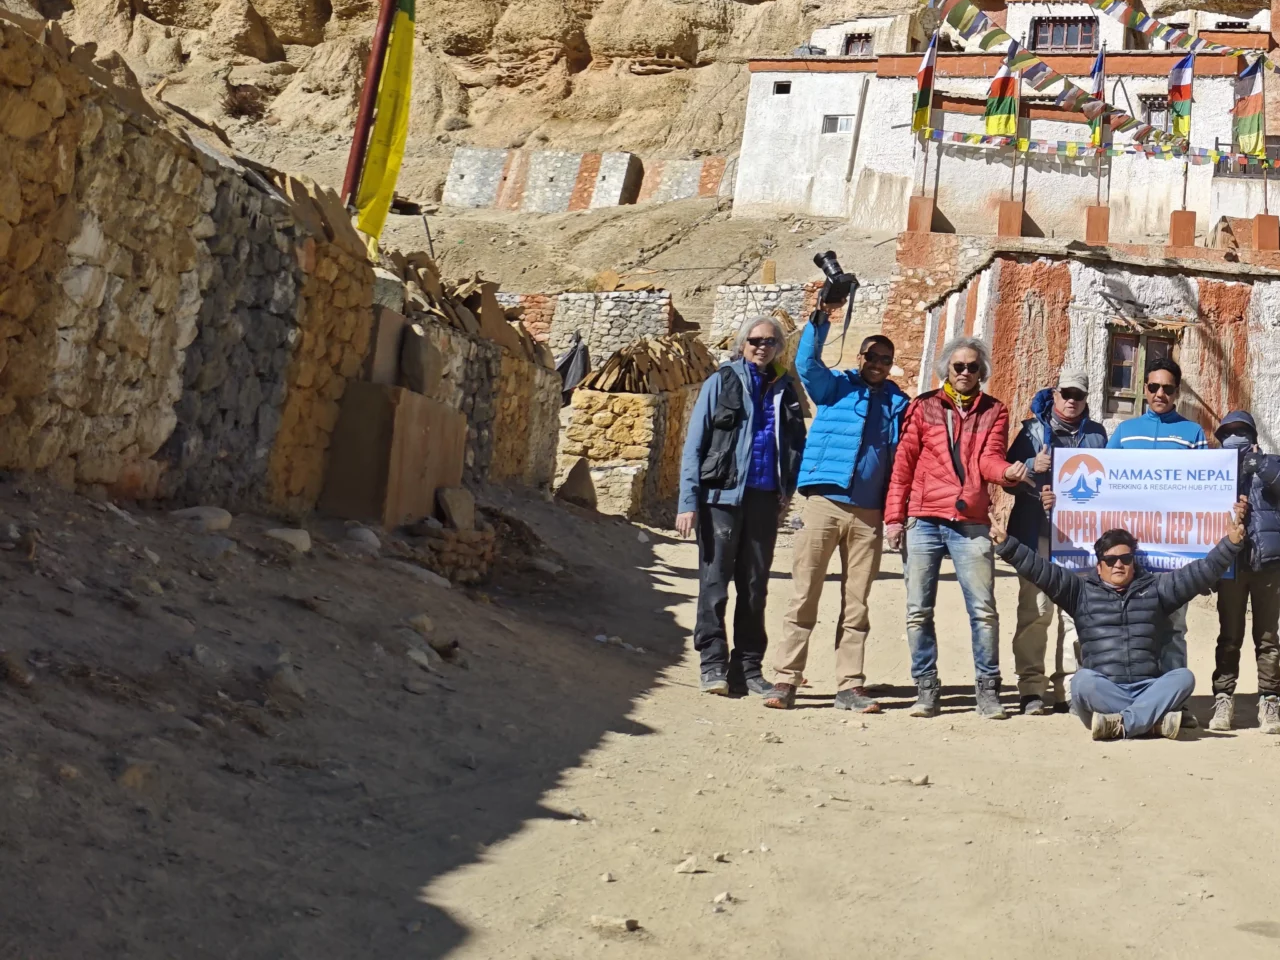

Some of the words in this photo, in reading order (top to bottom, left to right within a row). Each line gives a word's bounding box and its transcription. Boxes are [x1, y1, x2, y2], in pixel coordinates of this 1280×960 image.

[1109, 469, 1182, 481] NAMASTE
[1187, 469, 1235, 481] NEPAL
[1057, 510, 1098, 544] UPPER
[1165, 511, 1193, 544] JEEP
